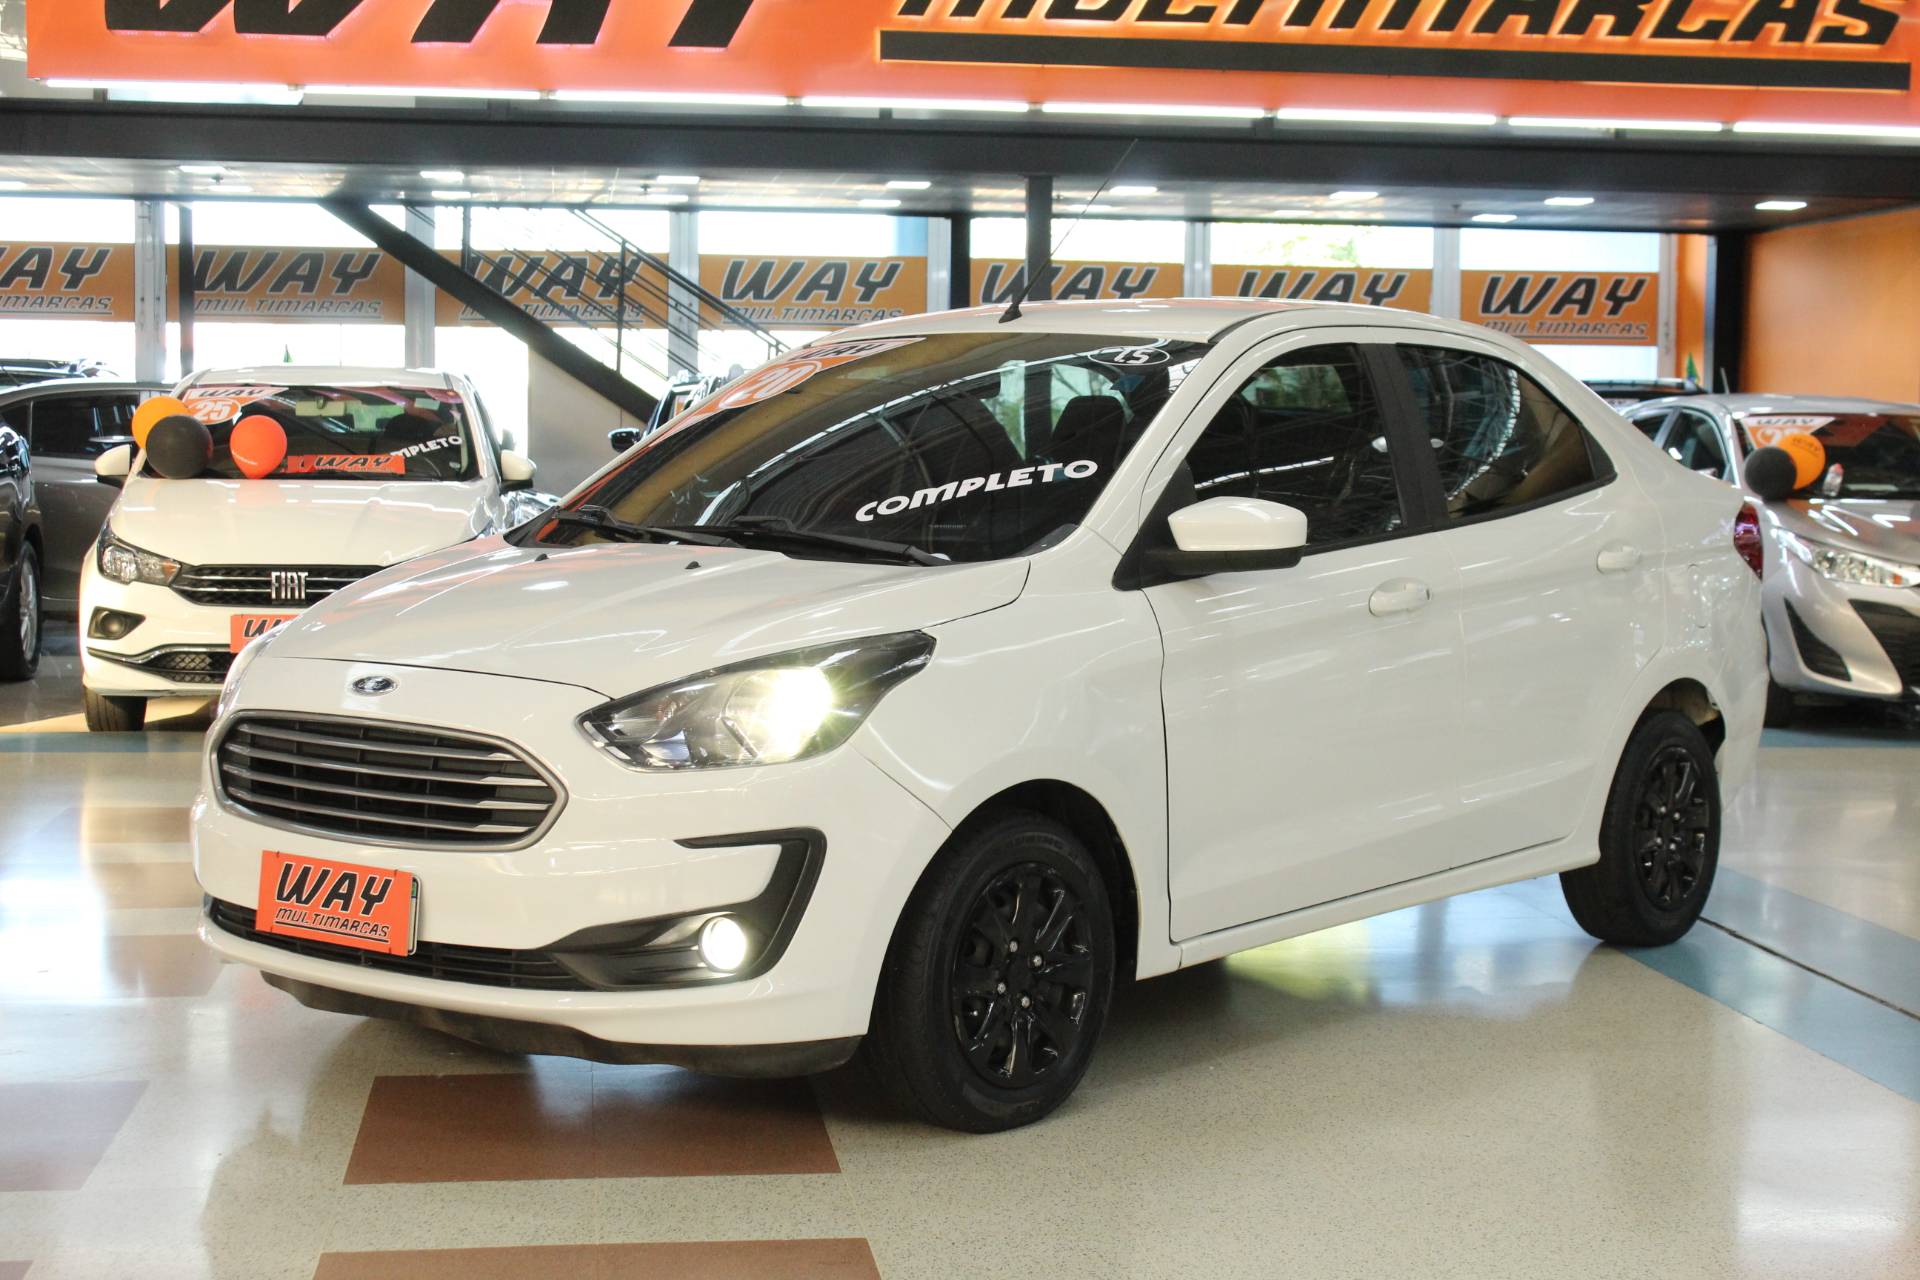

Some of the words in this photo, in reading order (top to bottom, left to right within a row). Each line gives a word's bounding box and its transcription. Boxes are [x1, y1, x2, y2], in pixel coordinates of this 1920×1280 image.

[0, 246, 112, 291] AY
[193, 250, 384, 295] WAY
[464, 255, 643, 300] WAY
[721, 259, 904, 304] WAY
[980, 262, 1160, 303] WAY
[0, 295, 113, 310] MARCAS
[1238, 270, 1409, 306] WAY
[1480, 274, 1649, 317] WAY
[194, 299, 383, 314] MULTIMARCAS
[1481, 320, 1649, 335] MULTIMARCAS
[190, 400, 235, 421] 25
[314, 455, 392, 467] WAY
[389, 435, 463, 458] MPLETO
[854, 459, 1099, 522] COMPLETO
[271, 571, 309, 599] FIAT
[275, 861, 395, 918] WAY
[275, 906, 391, 938] MULTIMARCAS
